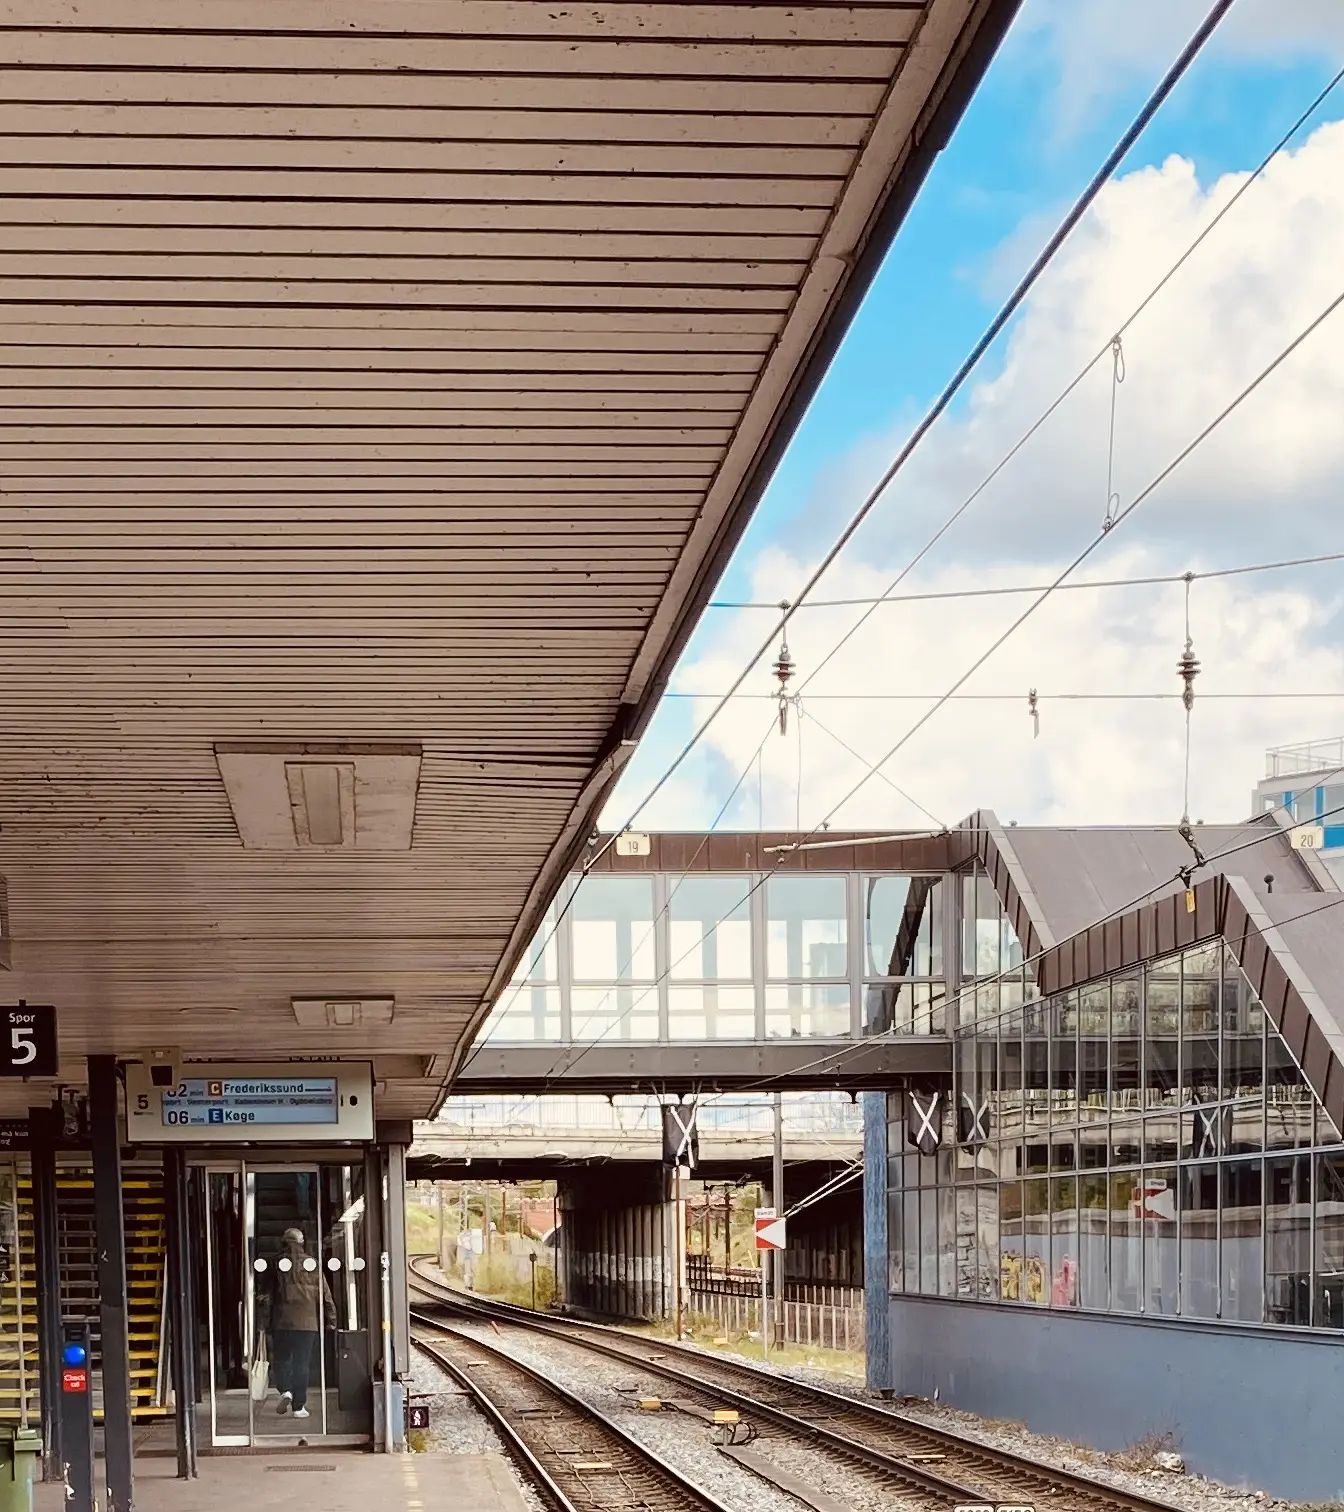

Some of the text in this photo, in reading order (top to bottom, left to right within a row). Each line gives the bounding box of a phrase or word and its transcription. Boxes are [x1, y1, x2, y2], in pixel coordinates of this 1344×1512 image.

[628, 840, 639, 854] 19
[1300, 834, 1314, 848] 20
[8, 1012, 36, 1025] Spor
[11, 1027, 37, 1065] 5
[224, 1083, 304, 1094] Frederikssund
[137, 1094, 149, 1110] 5
[167, 1110, 189, 1125] 06
[225, 1111, 256, 1123] Køge
